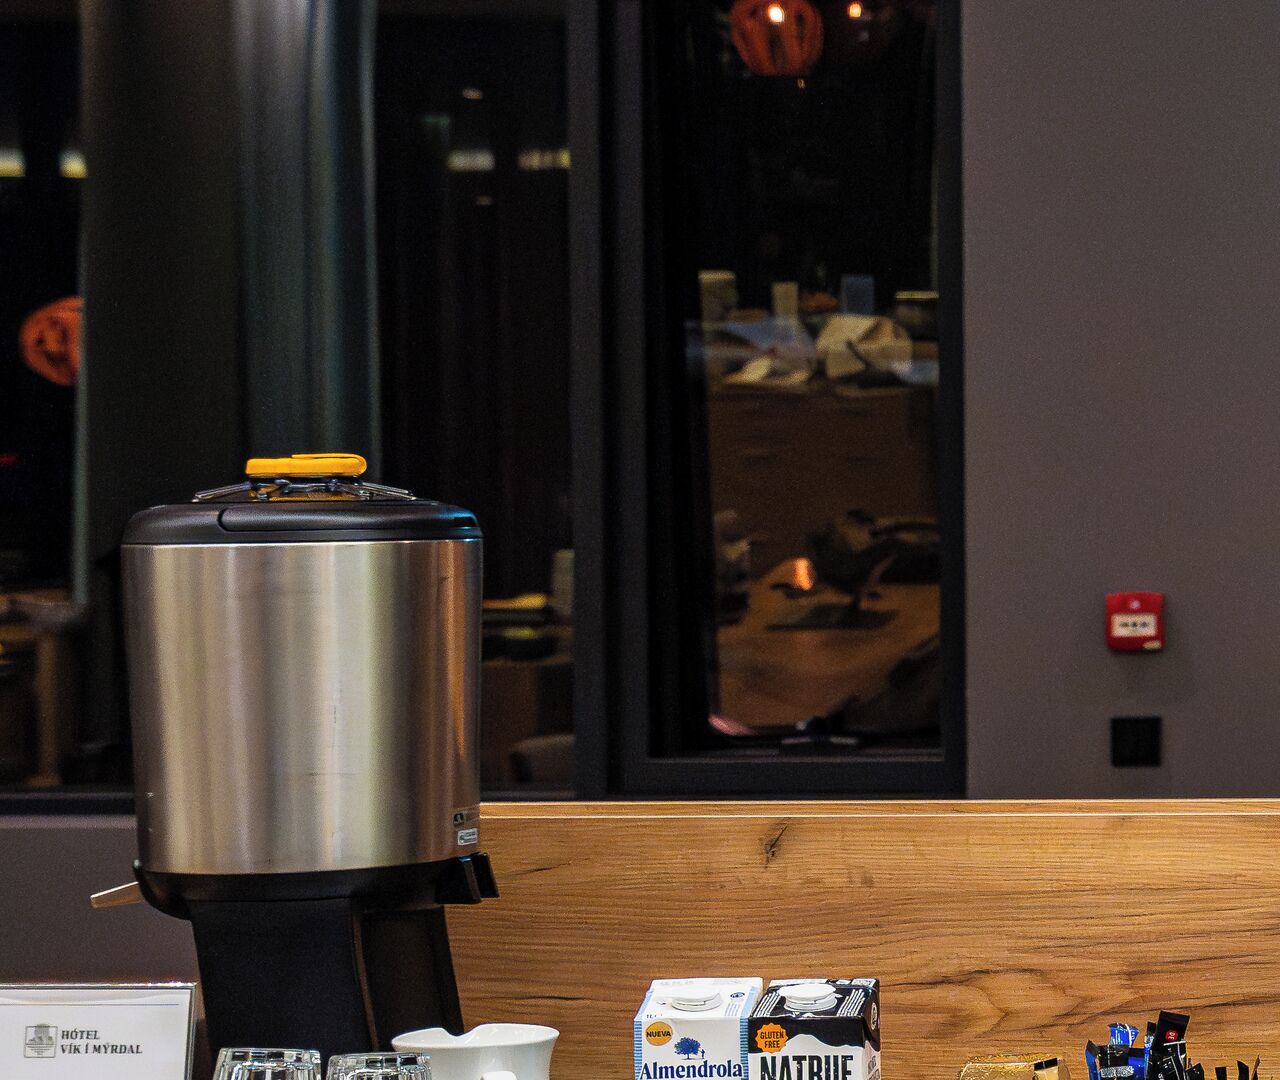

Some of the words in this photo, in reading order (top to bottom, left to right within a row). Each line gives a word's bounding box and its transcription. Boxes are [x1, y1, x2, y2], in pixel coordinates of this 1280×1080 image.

[61, 1028, 100, 1040] HÓTEL
[60, 1043, 81, 1054] VÍK
[92, 1042, 143, 1054] MÝRDAL
[640, 1060, 743, 1080] Almendrola
